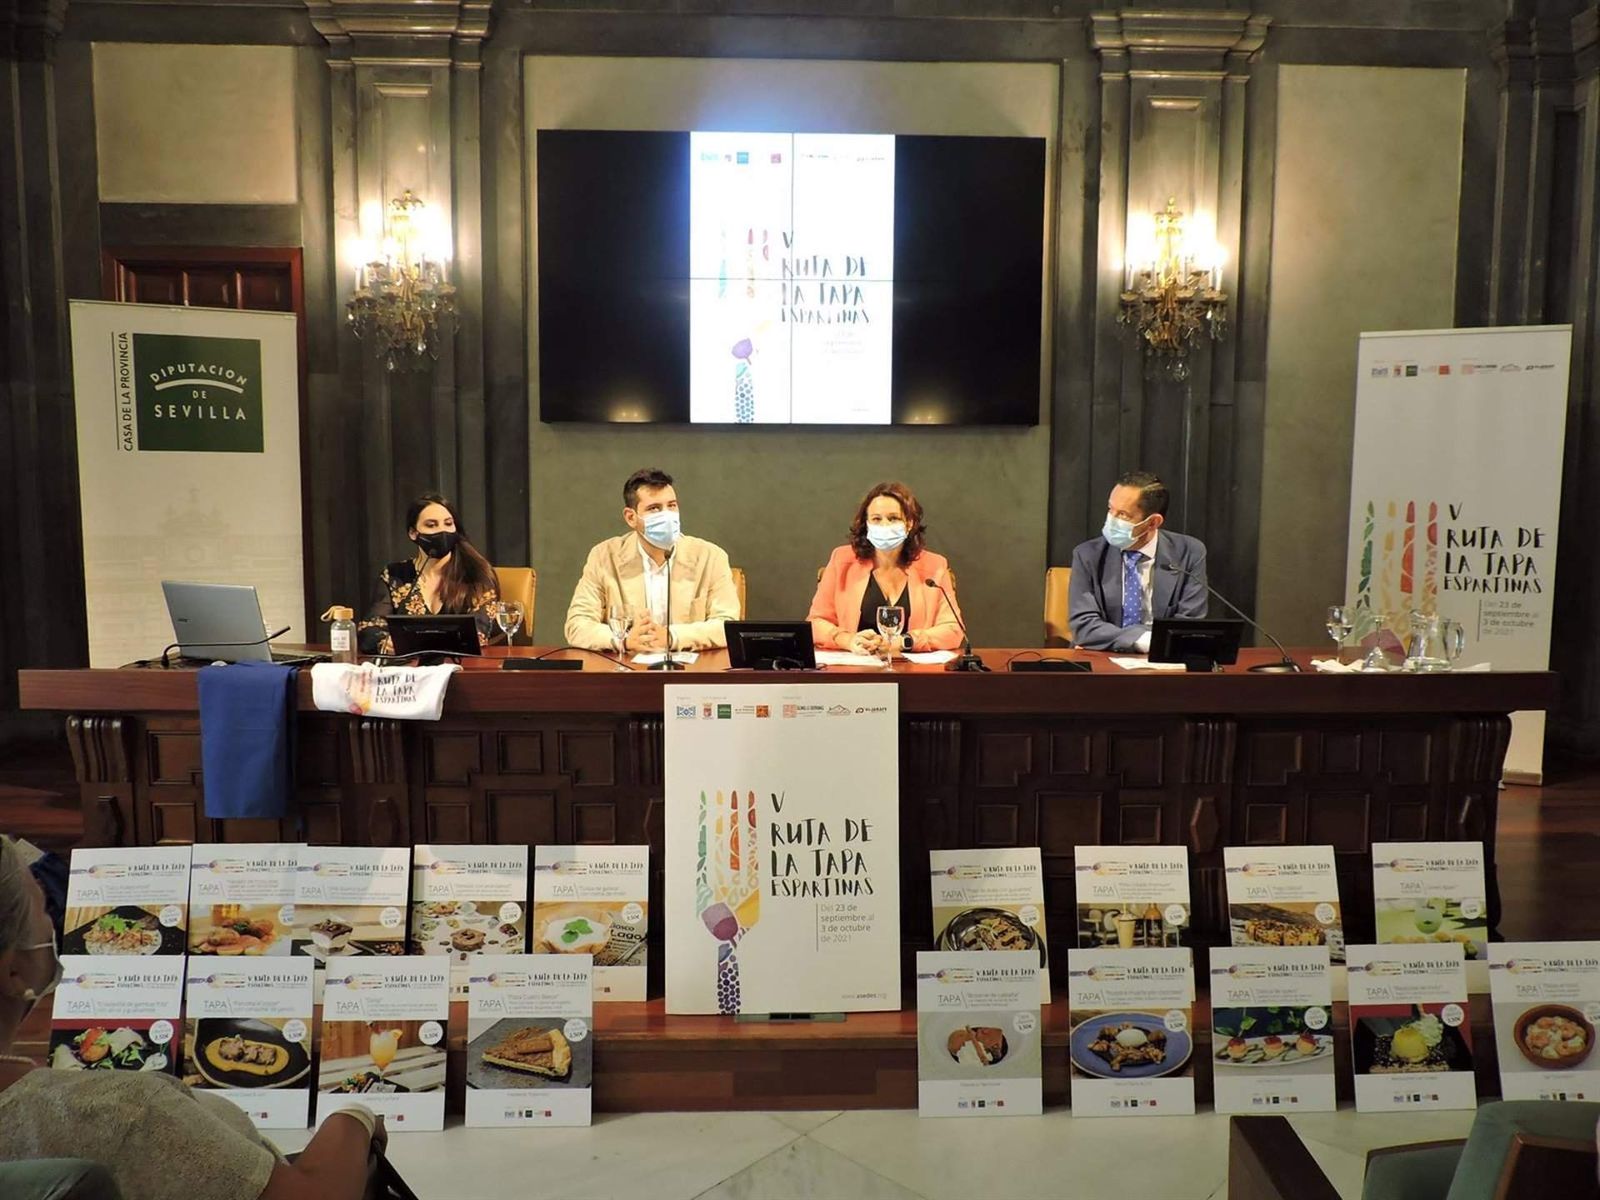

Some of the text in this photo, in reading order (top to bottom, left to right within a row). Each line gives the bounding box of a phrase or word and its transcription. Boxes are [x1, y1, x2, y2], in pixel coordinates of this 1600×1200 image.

[150, 363, 247, 385] DIPUTACION
[118, 333, 133, 451] CASA DE LA PROVINCIA
[192, 390, 208, 399] DE
[154, 405, 246, 420] SEVILLA
[1449, 503, 1463, 520] V
[1447, 526, 1545, 549] RUTA DE
[1445, 552, 1537, 575] LA TAPA
[1444, 577, 1542, 594] ESPARTINAS
[1483, 610, 1529, 618] septiembre
[1502, 620, 1535, 628] octubre
[771, 791, 785, 813] V
[771, 818, 874, 847] RUTA DE
[771, 848, 867, 877] LA TAPA
[199, 884, 219, 892] TAPA
[302, 887, 321, 895] TAPA
[771, 877, 874, 898] ESPARTINAS
[941, 890, 963, 898] TAPA
[821, 904, 833, 912] Del
[821, 913, 866, 923] septiembre
[821, 924, 871, 932] 3 de octubre
[821, 934, 852, 942] de 2021
[67, 1001, 90, 1009] TAPA
